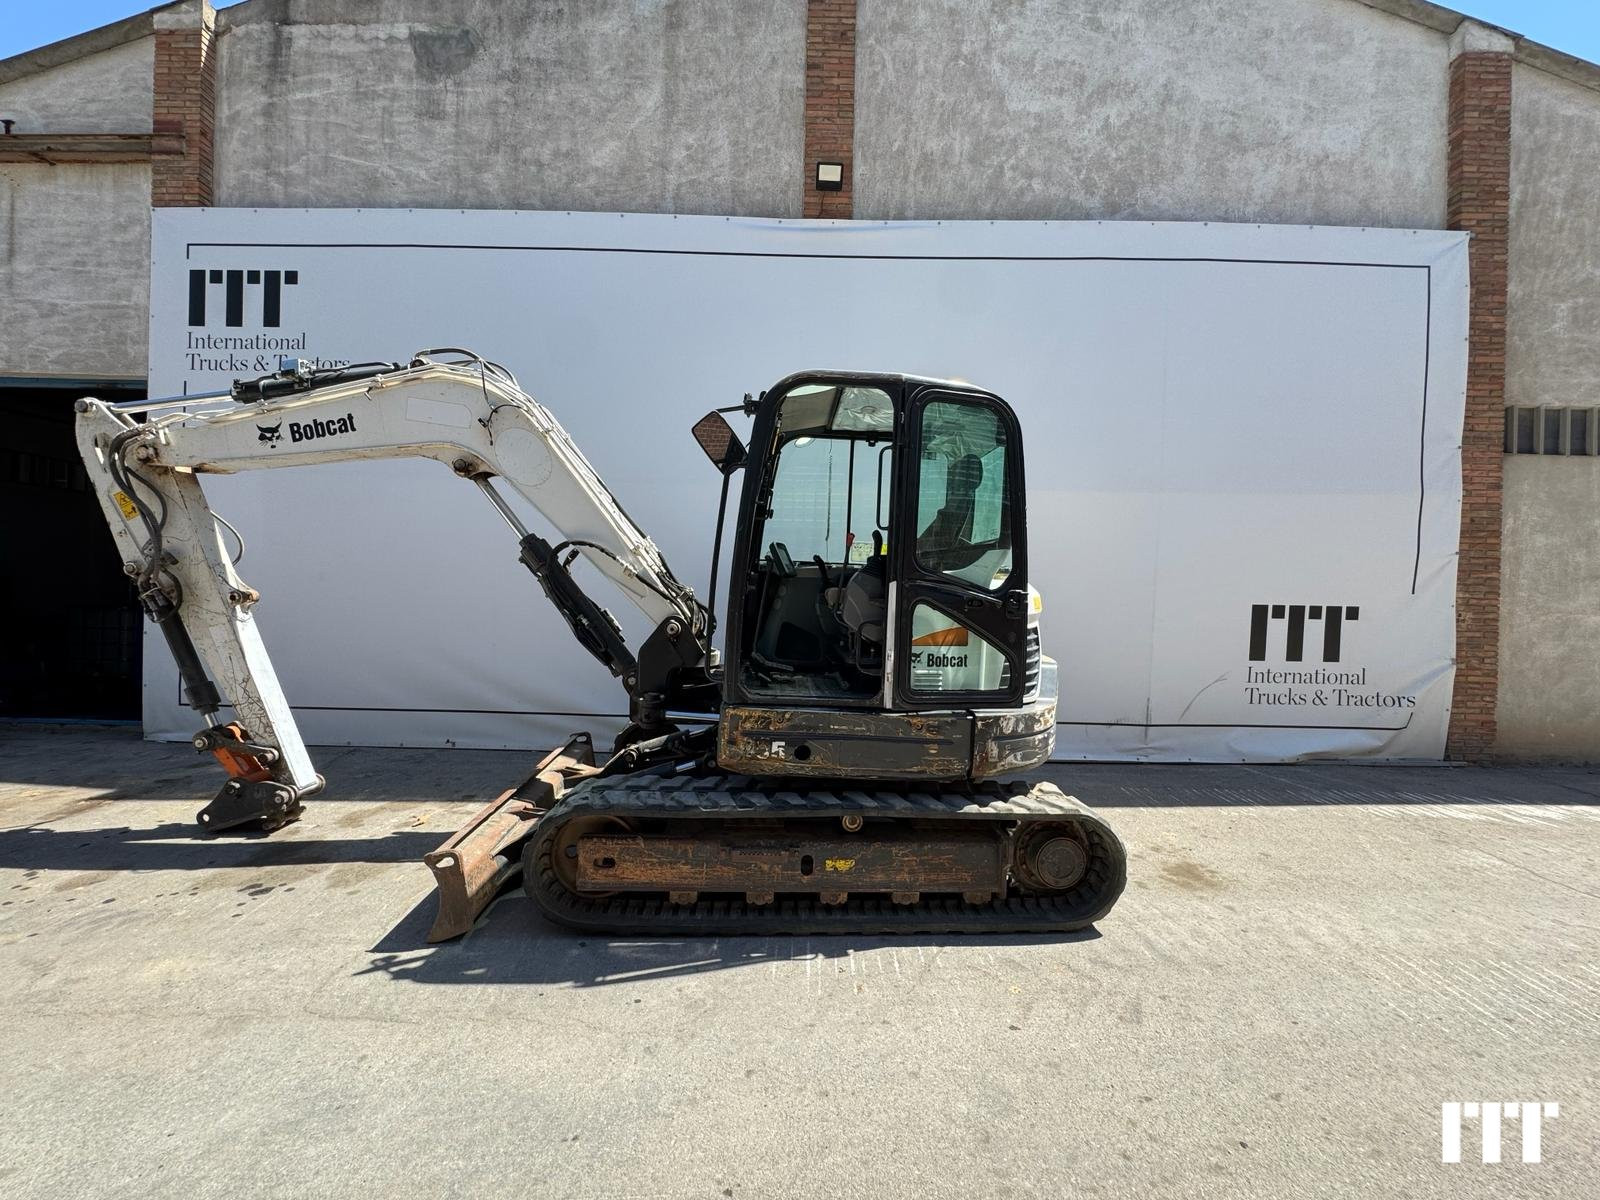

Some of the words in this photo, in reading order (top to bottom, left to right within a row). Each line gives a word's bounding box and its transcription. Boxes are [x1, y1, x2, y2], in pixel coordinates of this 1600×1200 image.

[187, 332, 306, 350] International
[186, 353, 249, 372] Trucks
[253, 354, 269, 372] &
[289, 413, 357, 443] Bobcat
[927, 653, 968, 668] Bobcat
[1246, 667, 1366, 685] International
[1245, 687, 1307, 706] Trucks
[1312, 689, 1328, 706] &
[1332, 688, 1416, 708] Tractors
